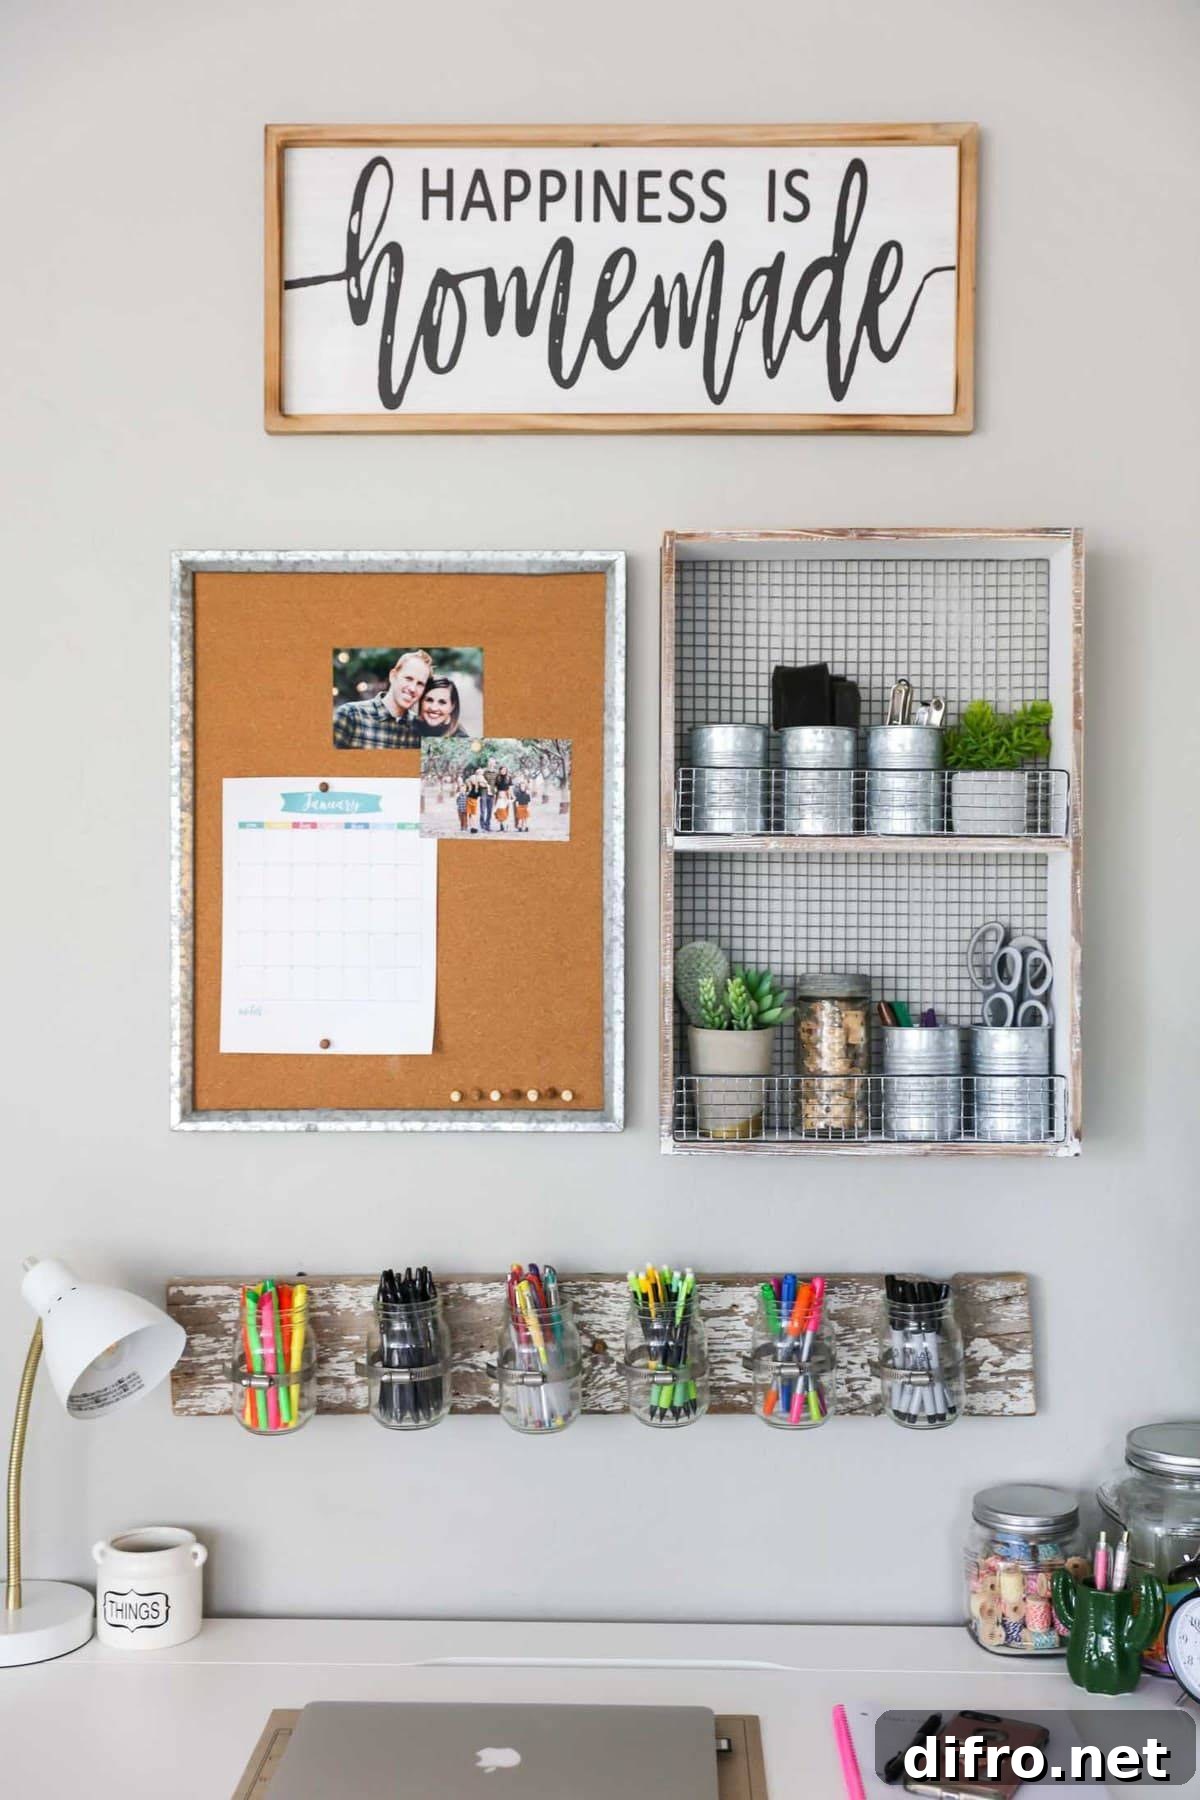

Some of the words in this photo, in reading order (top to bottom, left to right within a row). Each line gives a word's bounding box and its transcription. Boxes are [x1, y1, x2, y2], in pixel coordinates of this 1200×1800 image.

[422, 167, 727, 224] HAPPINESS
[767, 168, 811, 223] IS
[285, 156, 956, 410] homemade
[304, 793, 359, 813] January
[108, 1600, 160, 1620] THINGS
